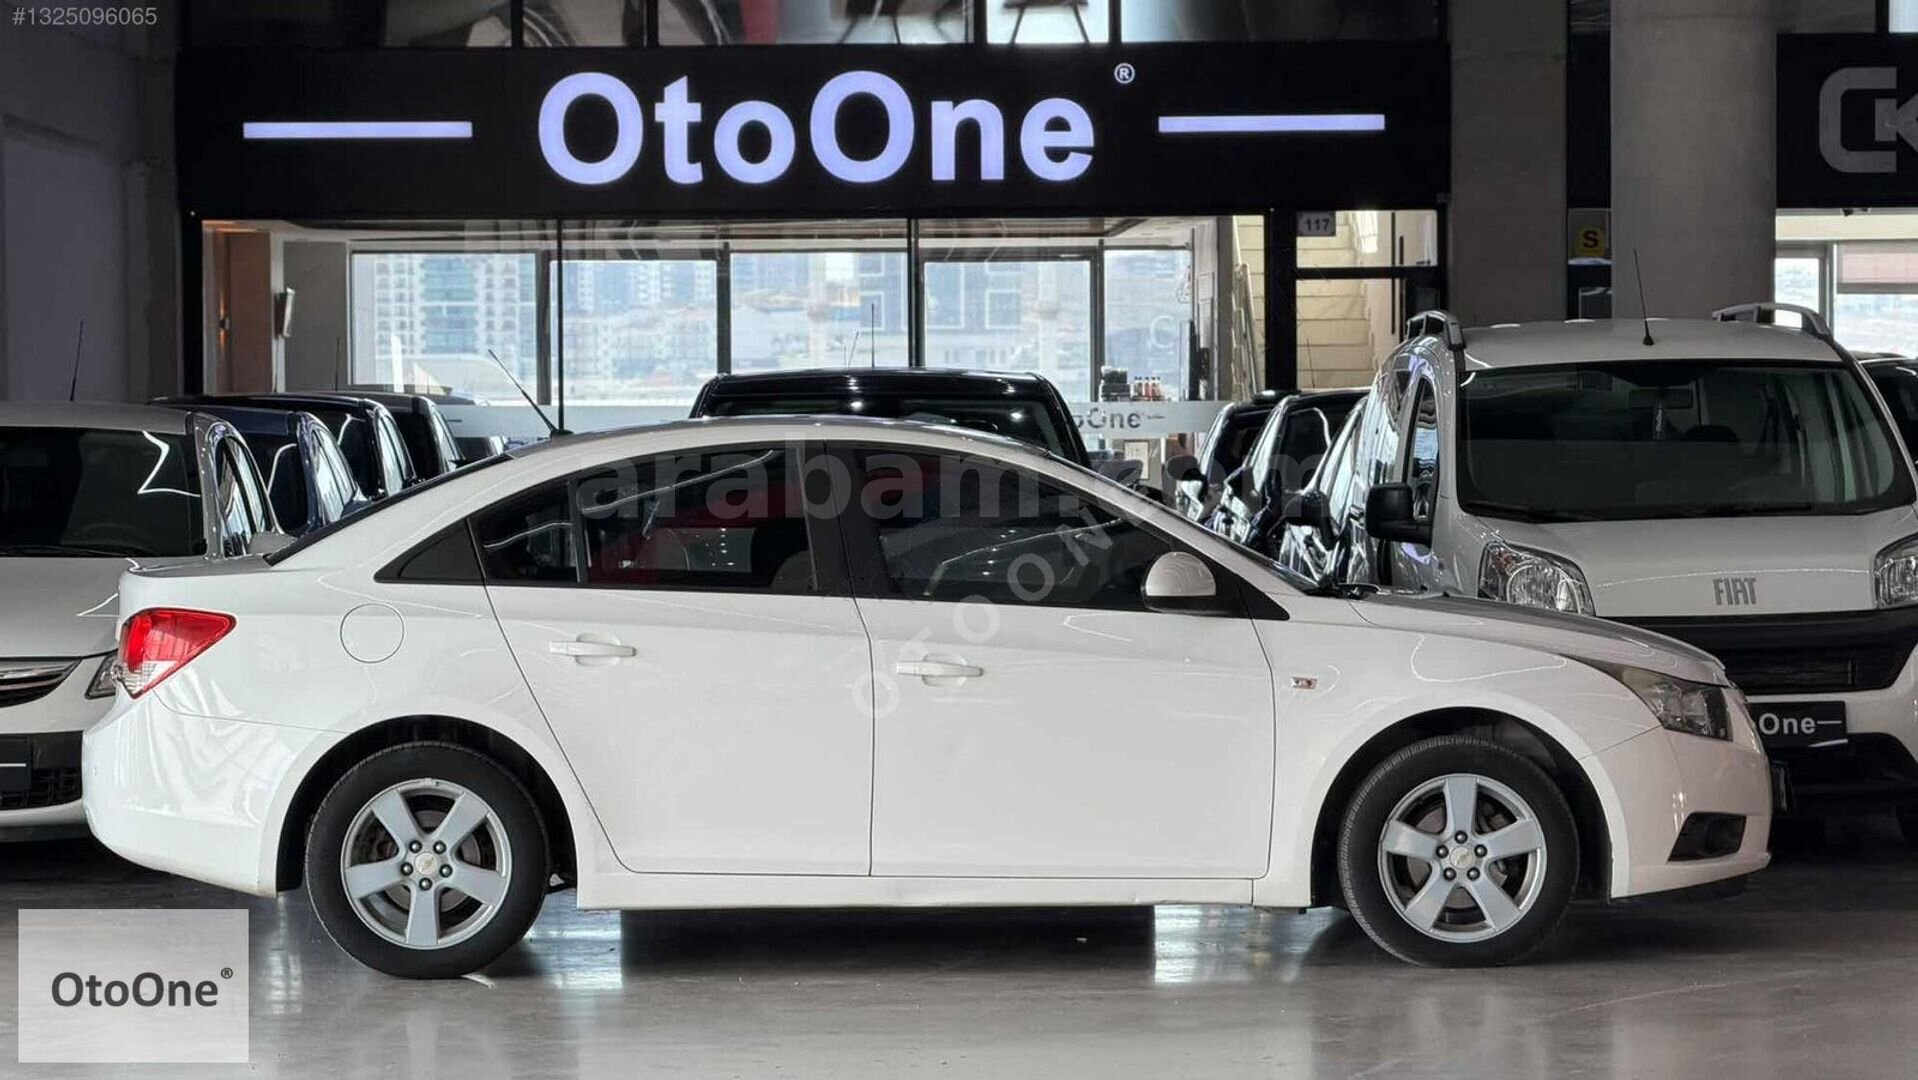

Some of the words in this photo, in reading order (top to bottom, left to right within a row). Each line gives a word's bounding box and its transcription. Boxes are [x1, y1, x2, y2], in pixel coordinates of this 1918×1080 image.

[1305, 218, 1331, 232] 117
[1582, 229, 1599, 249] S
[1712, 577, 1757, 606] FIAT
